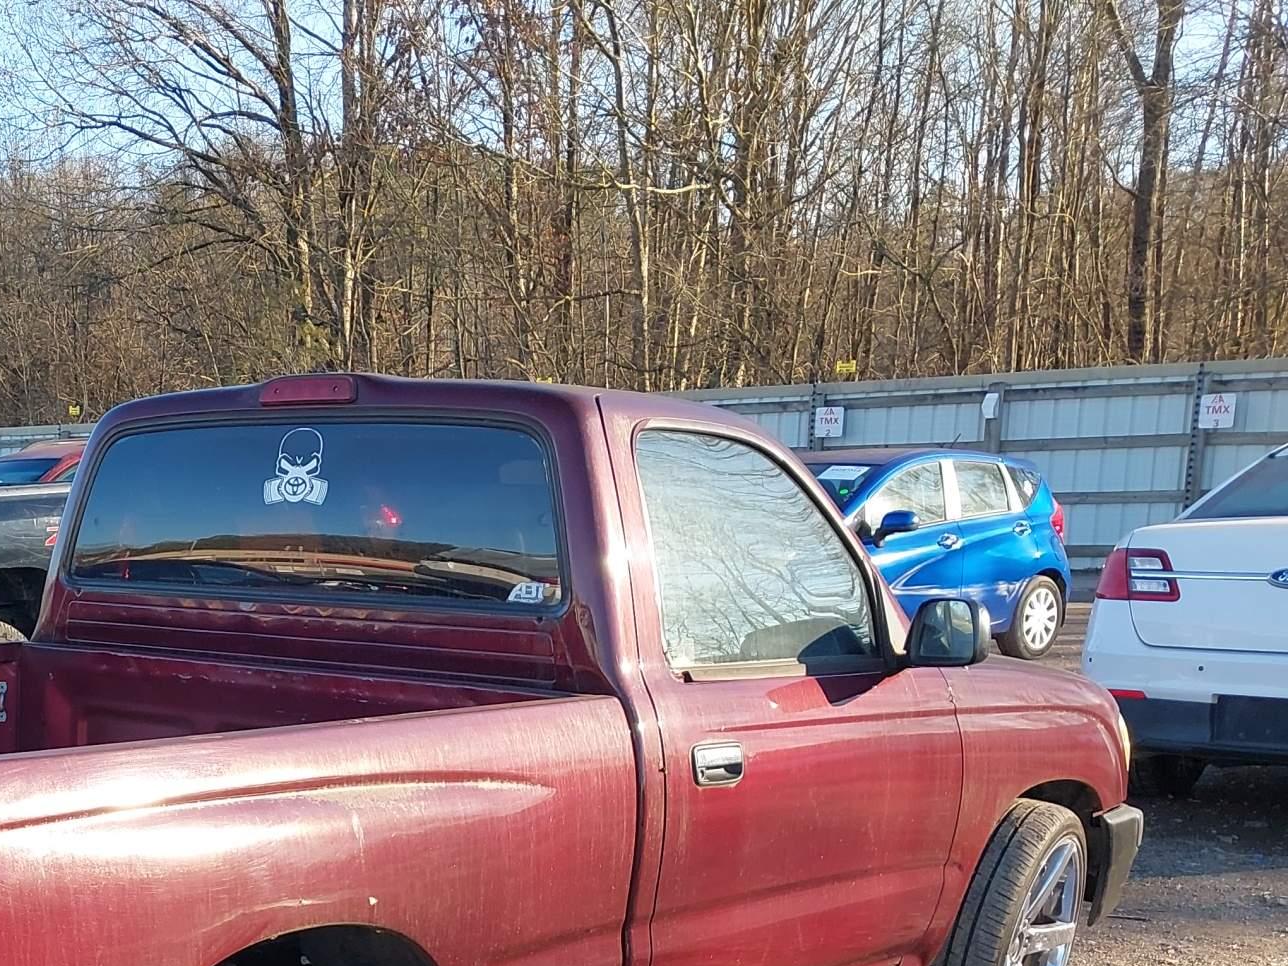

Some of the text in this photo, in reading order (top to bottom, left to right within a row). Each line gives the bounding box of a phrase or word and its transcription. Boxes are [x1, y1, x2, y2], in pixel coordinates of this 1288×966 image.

[1205, 405, 1230, 415] TMX
[819, 417, 840, 425] TMX
[1213, 419, 1220, 427] 3
[824, 429, 832, 437] 2
